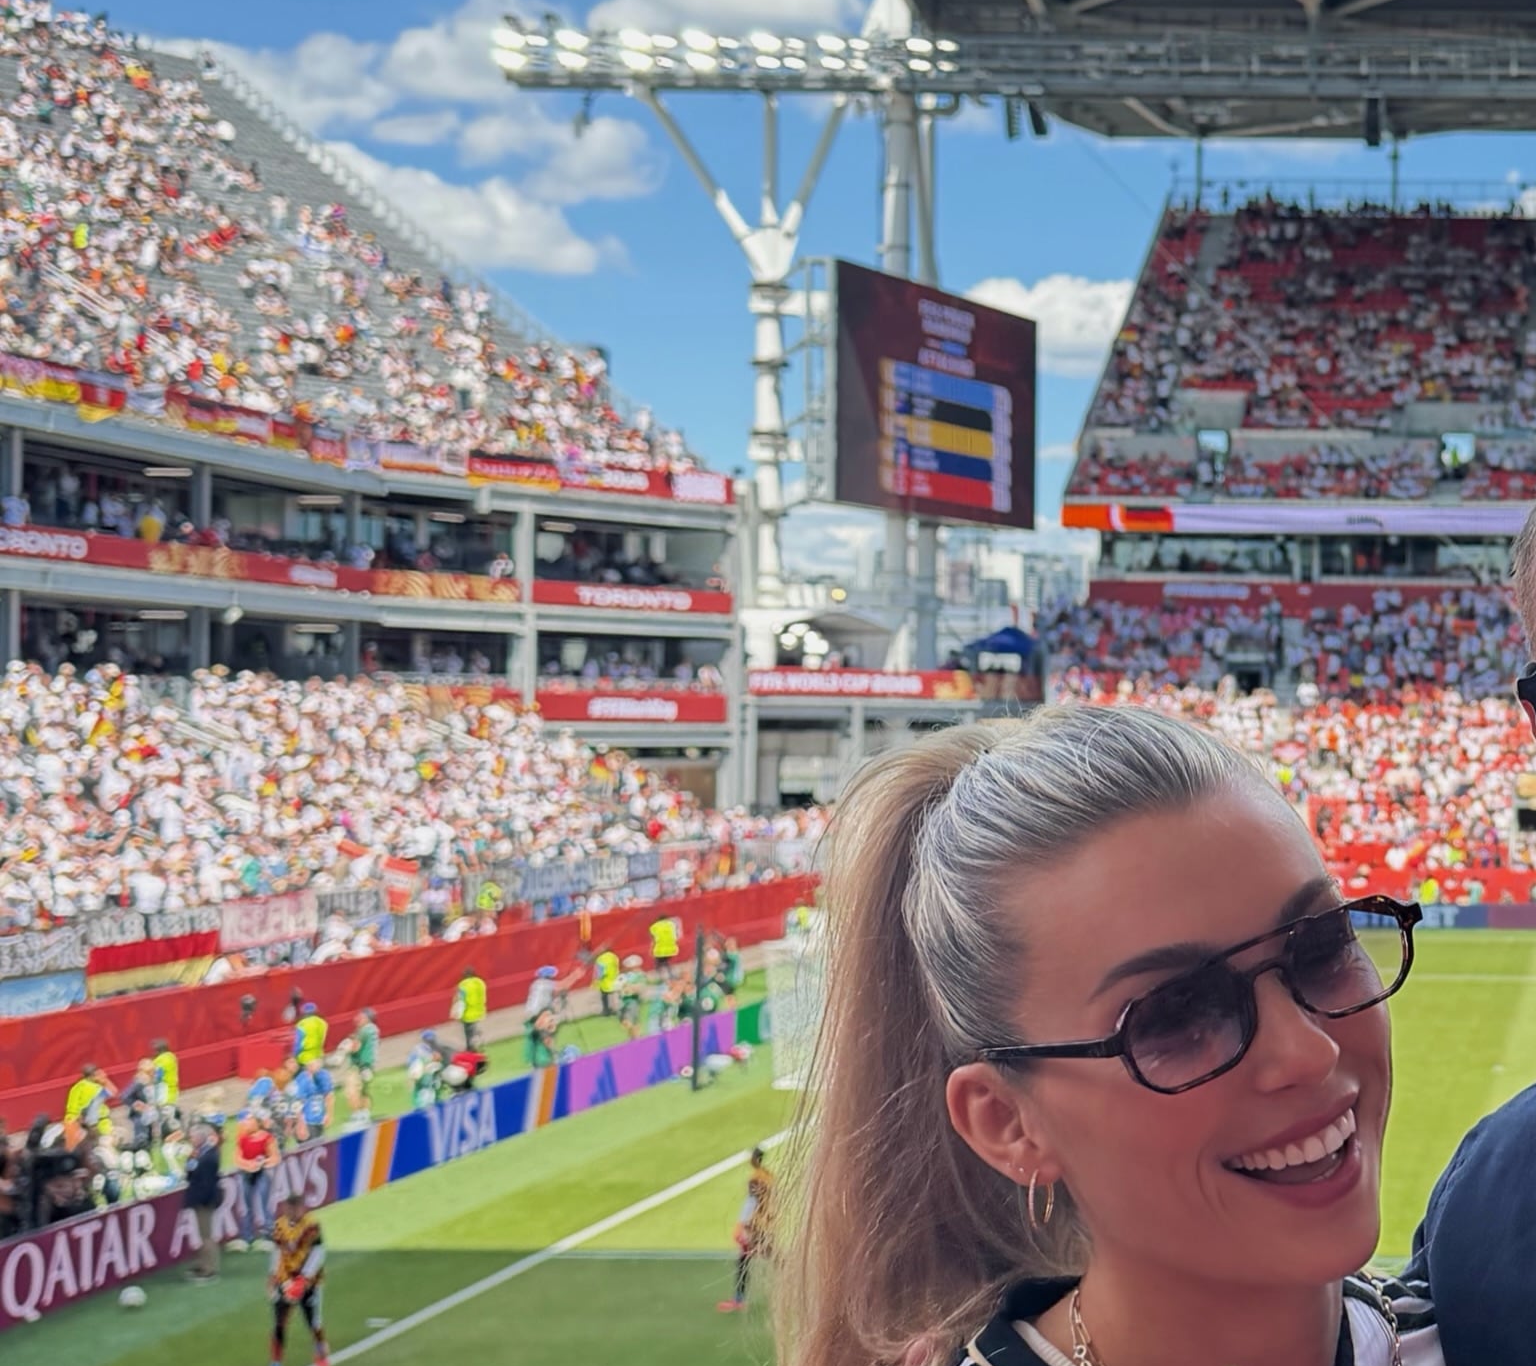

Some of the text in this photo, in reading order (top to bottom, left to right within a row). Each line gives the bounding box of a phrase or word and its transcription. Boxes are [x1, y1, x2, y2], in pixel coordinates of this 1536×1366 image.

[575, 585, 693, 610] TORONTO
[427, 1088, 497, 1150] VISA
[1, 1203, 158, 1324] QATAR
